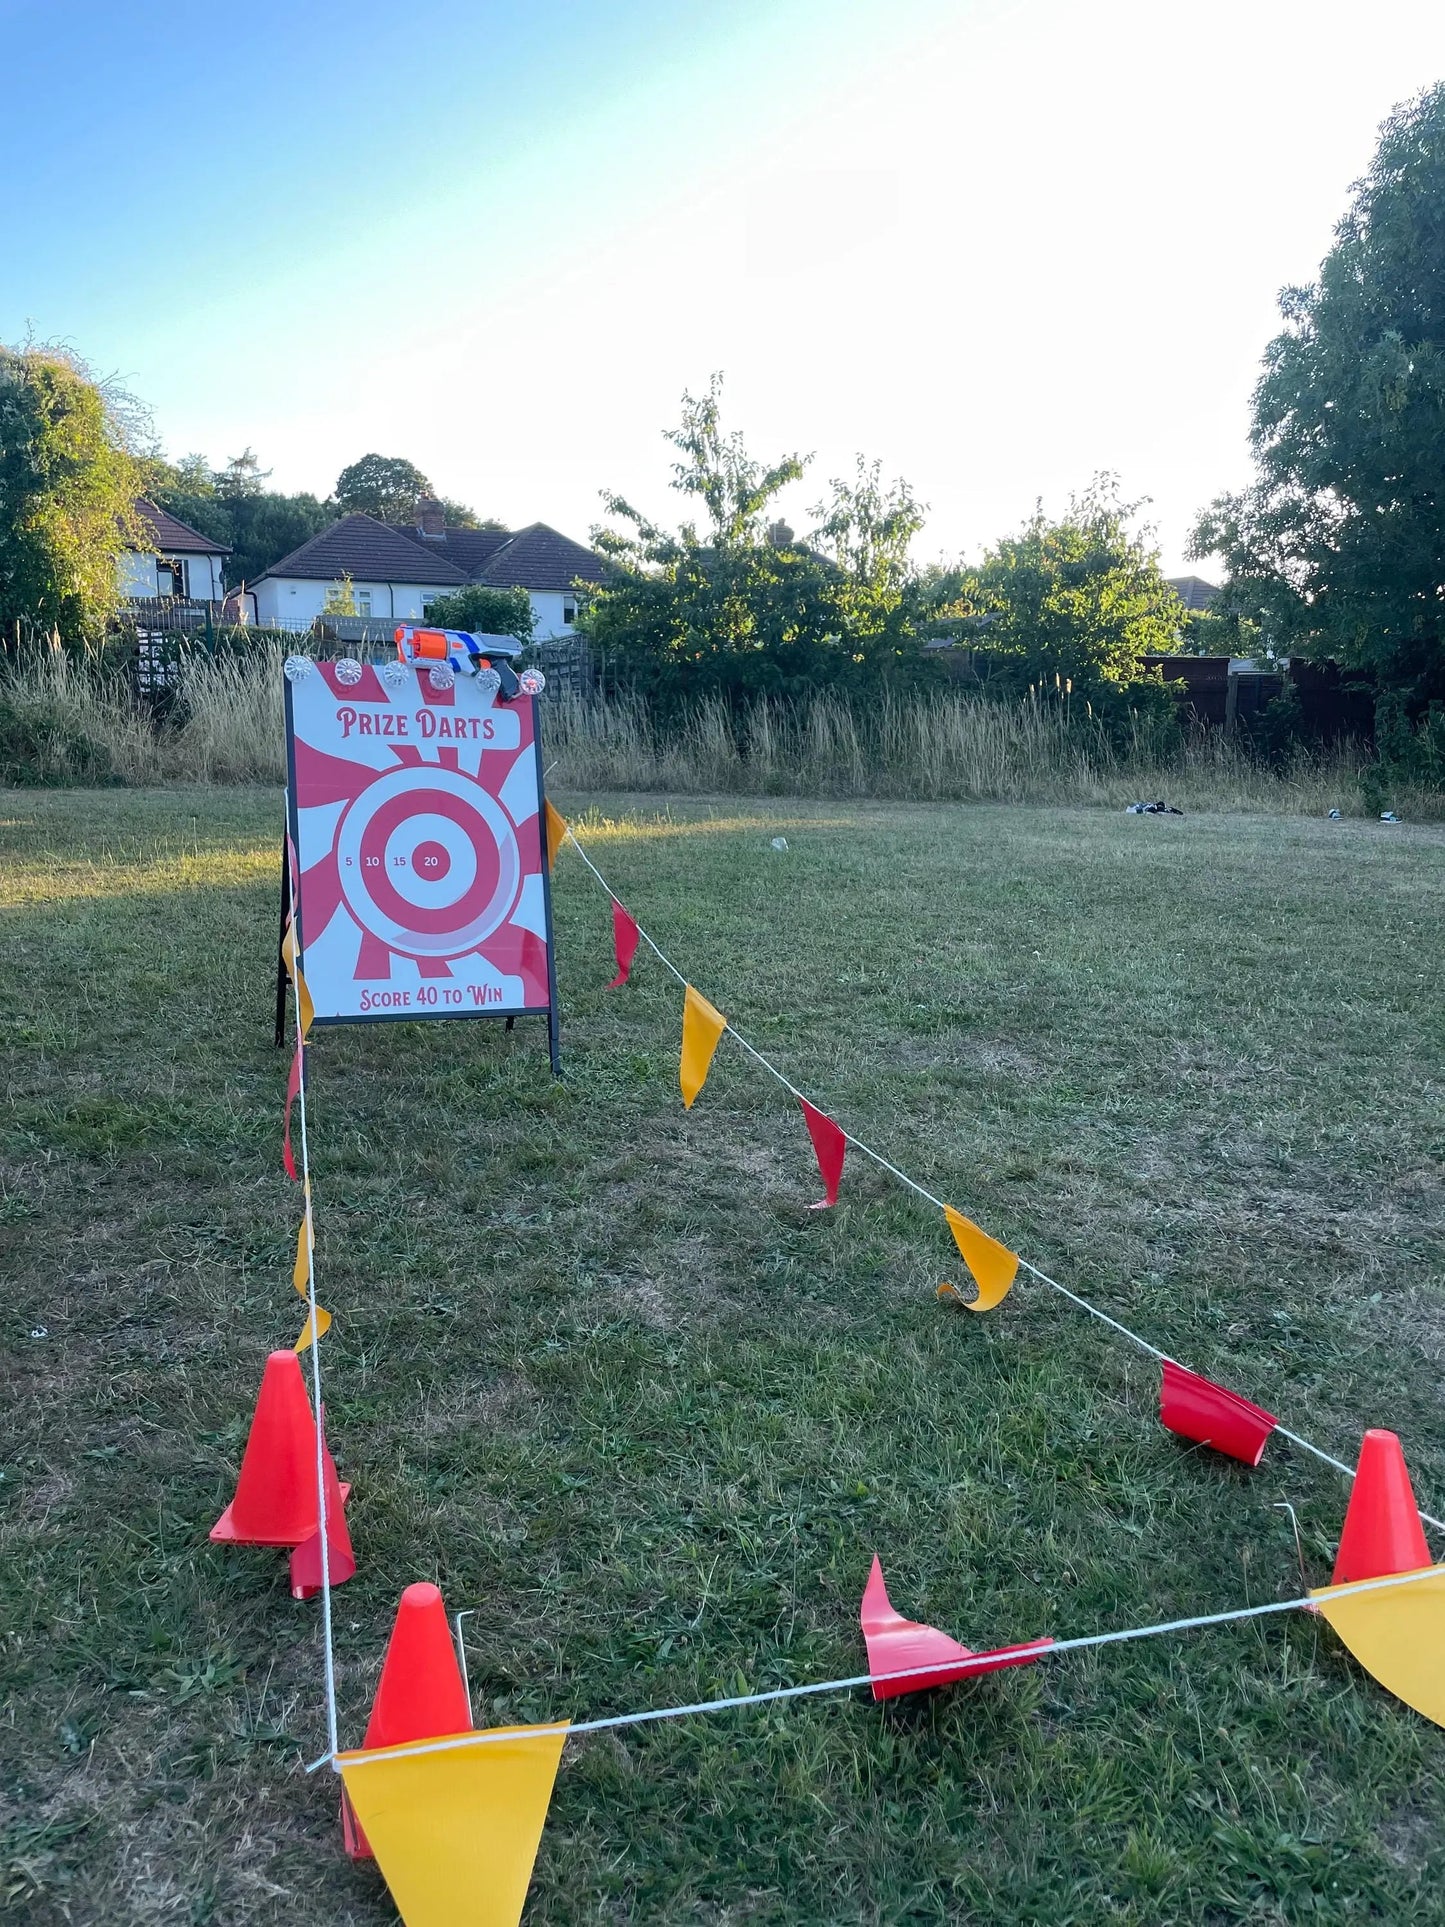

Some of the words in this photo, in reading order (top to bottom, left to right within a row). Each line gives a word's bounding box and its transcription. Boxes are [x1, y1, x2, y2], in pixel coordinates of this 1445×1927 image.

[336, 706, 409, 739] PRIZE
[415, 708, 495, 740] DARTS
[345, 856, 353, 866] 5
[366, 856, 380, 867] 10
[393, 856, 407, 866] 15
[424, 856, 438, 867] 20
[416, 986, 438, 1005] 40
